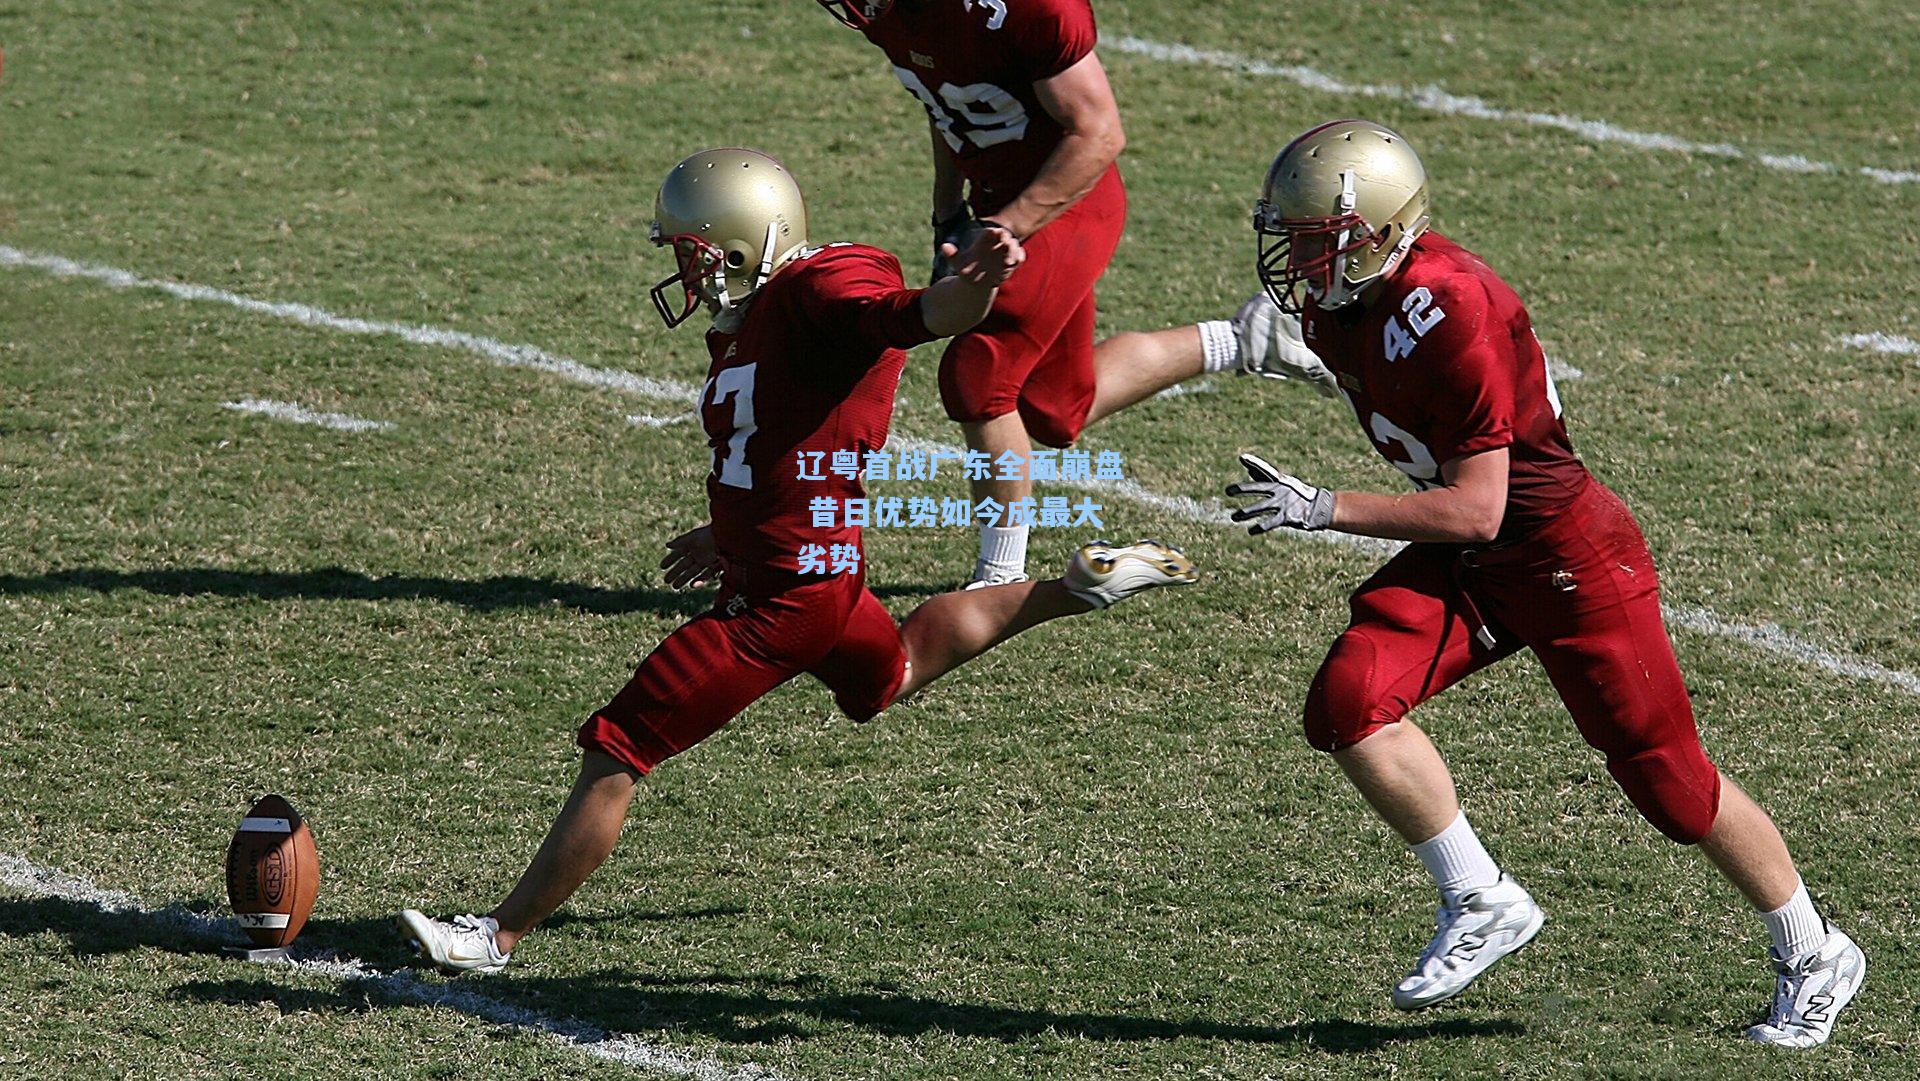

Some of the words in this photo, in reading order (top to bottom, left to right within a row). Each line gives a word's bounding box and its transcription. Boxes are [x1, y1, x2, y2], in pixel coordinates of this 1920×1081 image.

[1383, 286, 1446, 363] 42
[697, 361, 758, 490] 7
[1801, 995, 1835, 1023] N
